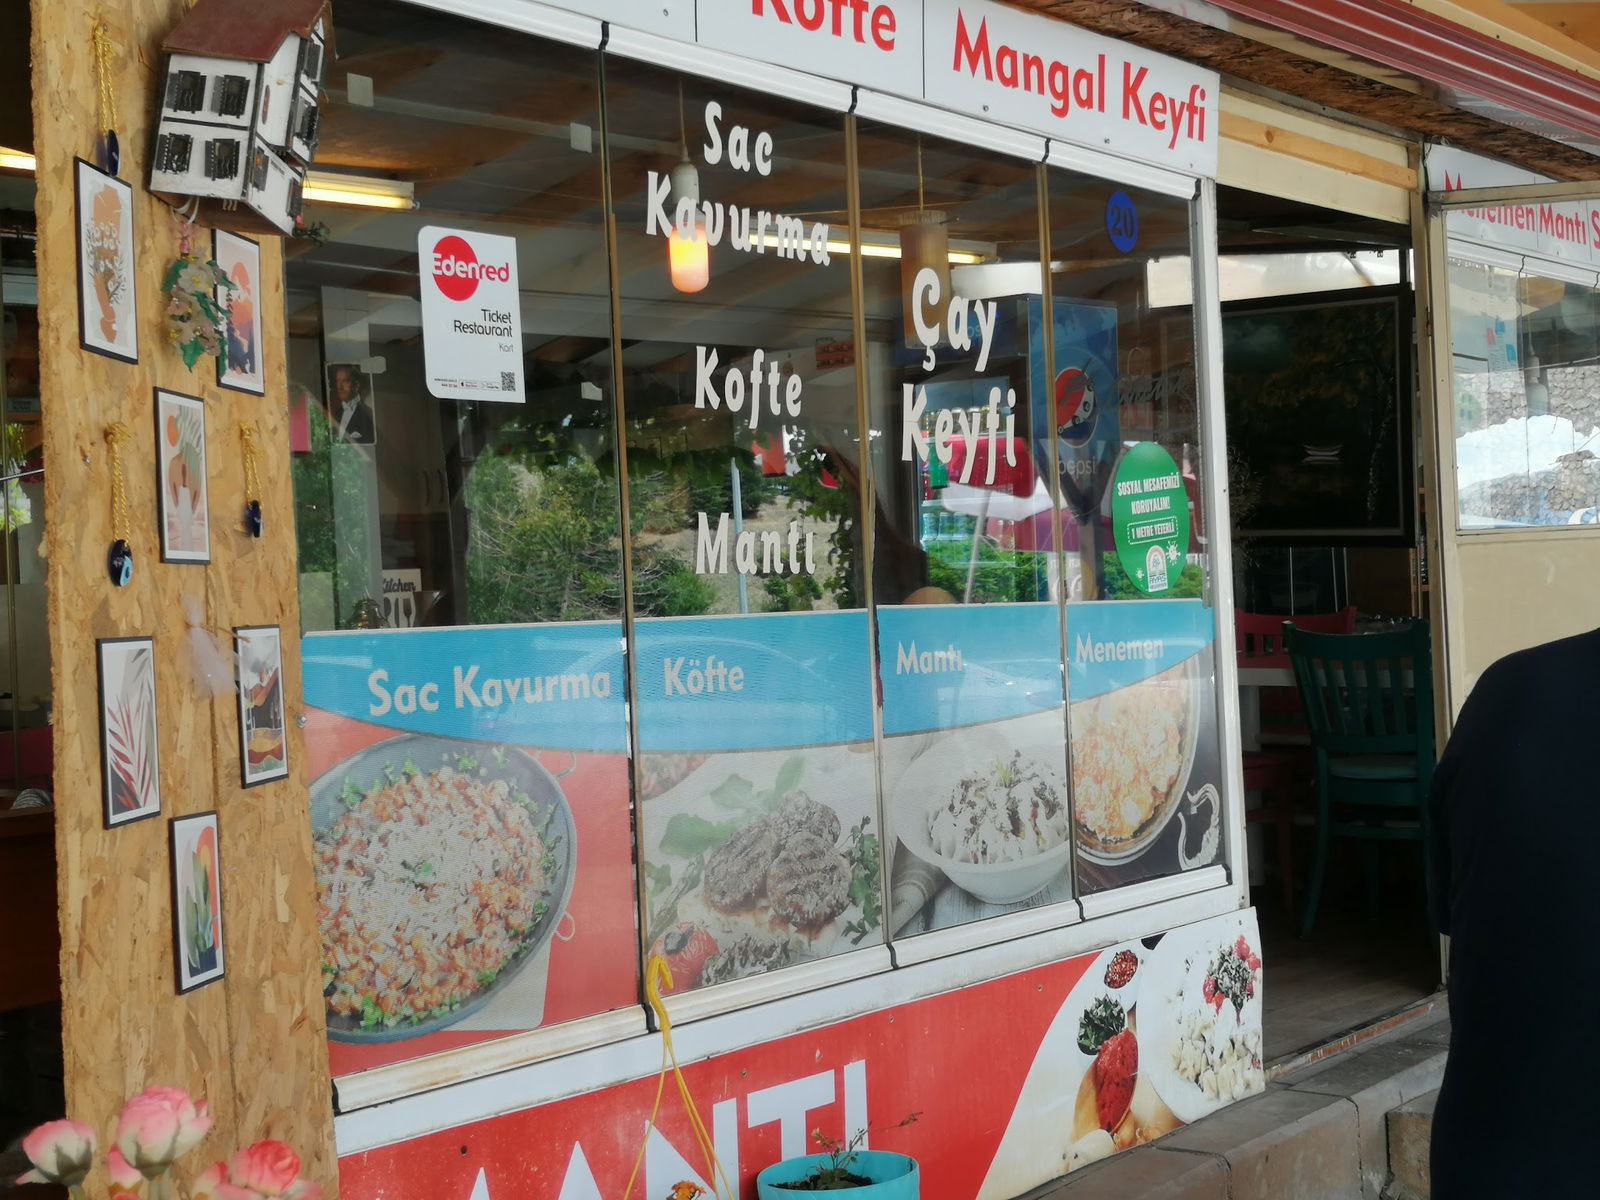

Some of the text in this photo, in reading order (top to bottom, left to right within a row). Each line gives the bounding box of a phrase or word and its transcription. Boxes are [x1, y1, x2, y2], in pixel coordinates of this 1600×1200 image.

[953, 8, 1206, 149] Mangal Keyfi
[703, 101, 773, 176] Sac
[646, 170, 831, 267] Kavurma
[1109, 205, 1136, 240] 20
[432, 252, 510, 283] Edenred
[454, 320, 513, 338] Restaurant
[481, 309, 512, 325] Ticket
[912, 267, 997, 372] Çay
[695, 346, 803, 429] Kofte
[902, 383, 1017, 485] Keyfi
[1059, 458, 1096, 477] pepsi
[1117, 480, 1142, 496] SOSYAL
[696, 512, 816, 576] Mantı
[896, 640, 963, 675] Mantı
[1076, 633, 1164, 666] Menemen
[368, 664, 611, 717] Sac Kavurma
[664, 655, 744, 696] Köfte
